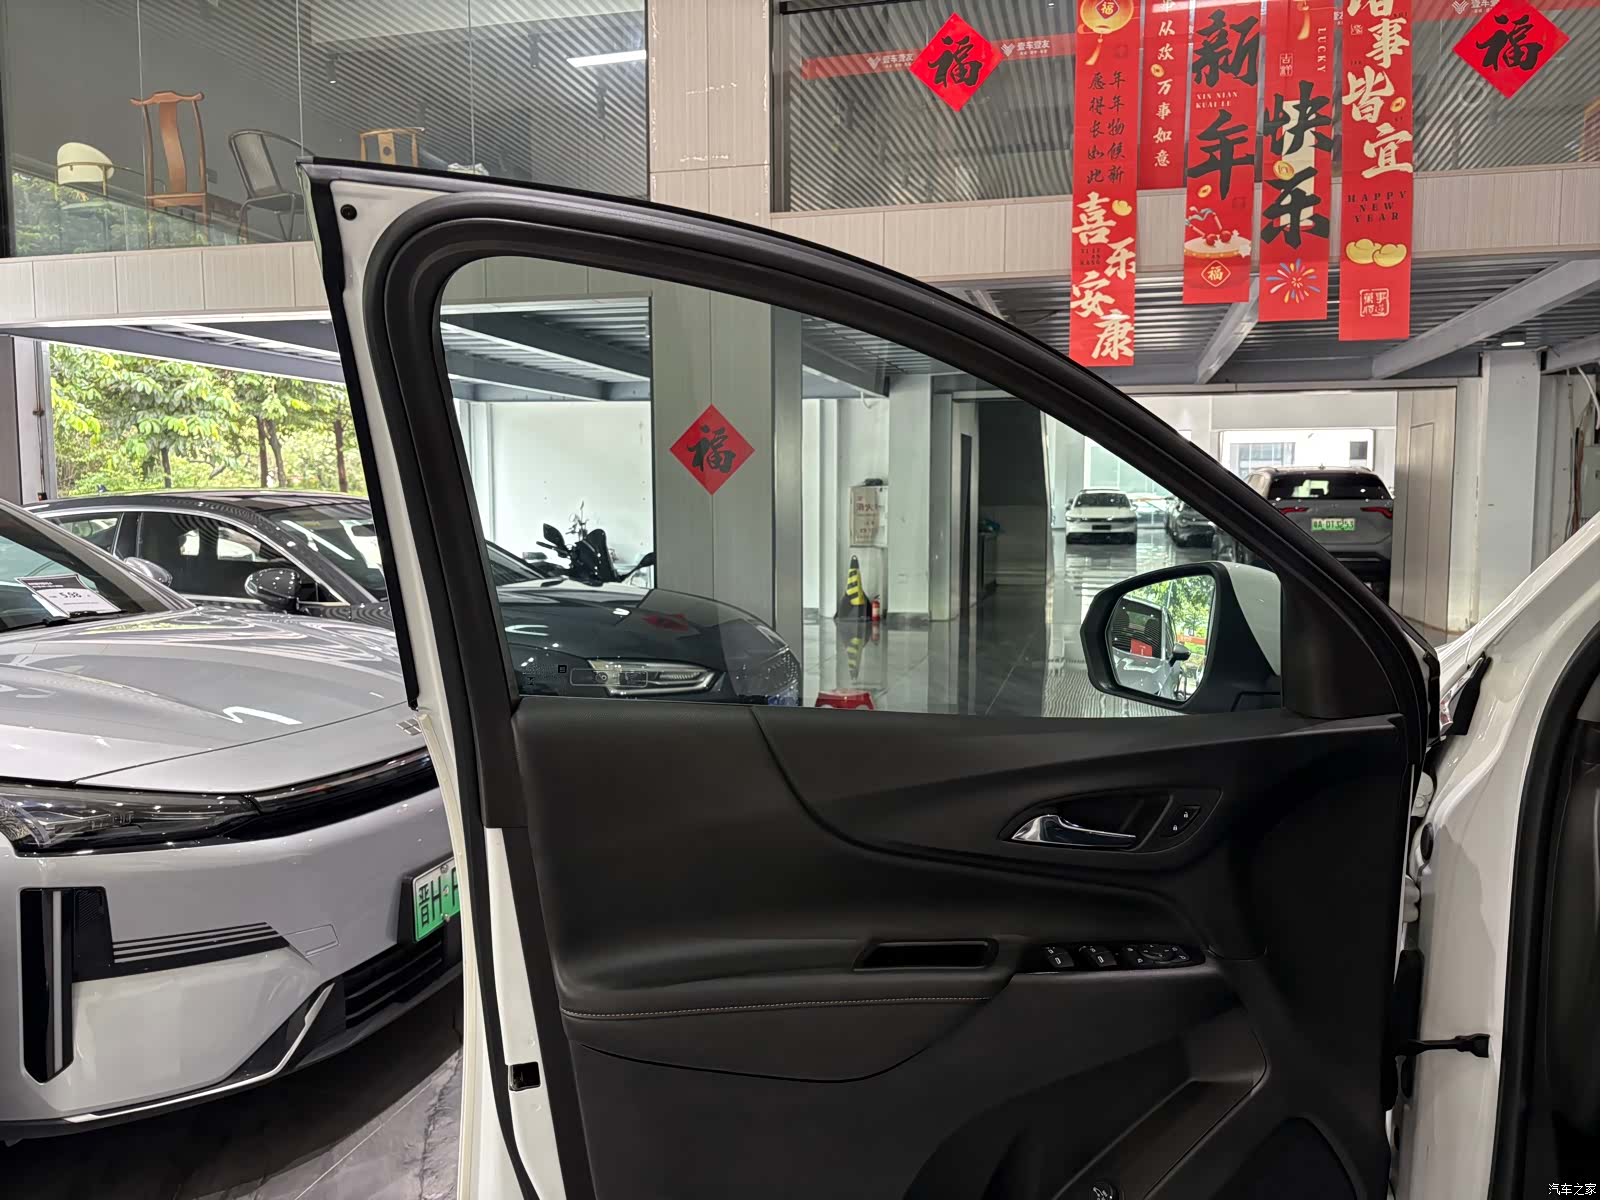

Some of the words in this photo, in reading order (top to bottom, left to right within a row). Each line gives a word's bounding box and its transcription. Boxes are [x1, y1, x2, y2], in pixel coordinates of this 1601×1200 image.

[1100, 0, 1115, 15] 福
[928, 35, 983, 88] 福
[1317, 27, 1327, 73] LUCKY
[1475, 13, 1544, 72] 福
[1107, 69, 1127, 184] 年年物候新
[1187, 8, 1261, 201] 新年
[1261, 80, 1336, 250] 快乐
[1347, 191, 1407, 203] HAPPY
[1354, 212, 1399, 223] YEAR
[1359, 202, 1394, 212] NEW
[1070, 191, 1136, 361] 喜乐安康
[1207, 265, 1224, 281] 福
[686, 424, 737, 474] 福
